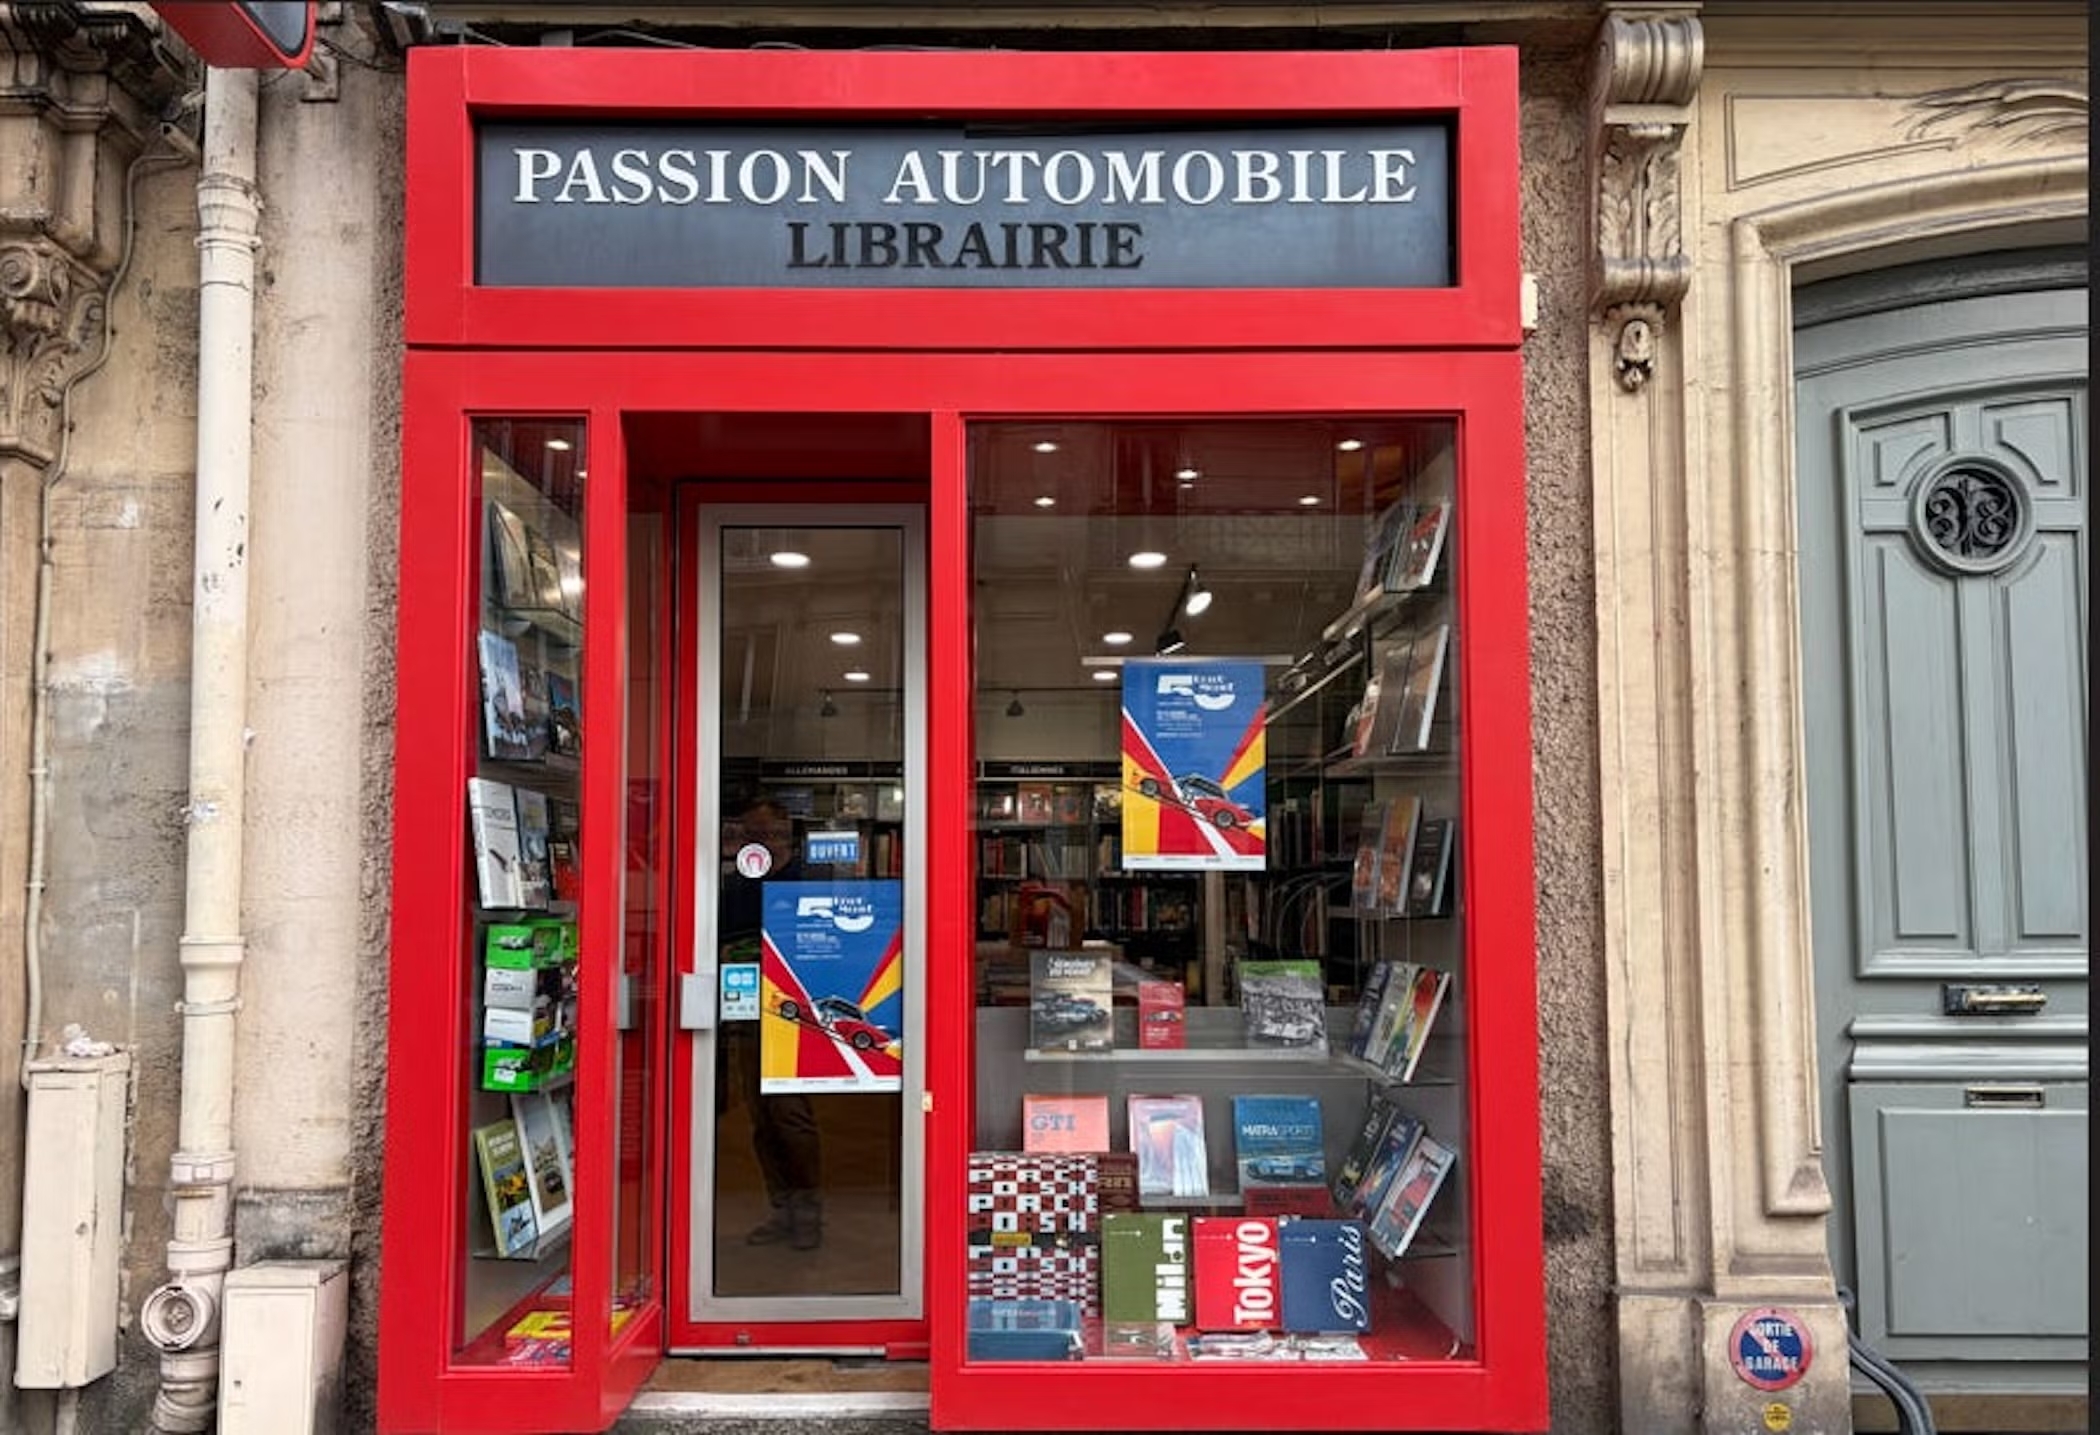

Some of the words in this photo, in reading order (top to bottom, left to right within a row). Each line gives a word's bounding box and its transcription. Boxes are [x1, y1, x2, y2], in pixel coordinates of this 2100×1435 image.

[513, 148, 852, 204] PASSION
[884, 149, 1418, 204] AUTOMOBILE
[785, 221, 1145, 269] LIBRAIRIE
[809, 843, 857, 860] OUVERT
[1031, 1114, 1077, 1131] GTI
[1155, 1218, 1186, 1320] Milan
[1233, 1221, 1280, 1325] Tokyo
[1330, 1225, 1369, 1327] Paris
[1745, 1356, 1799, 1371] GARAGE
